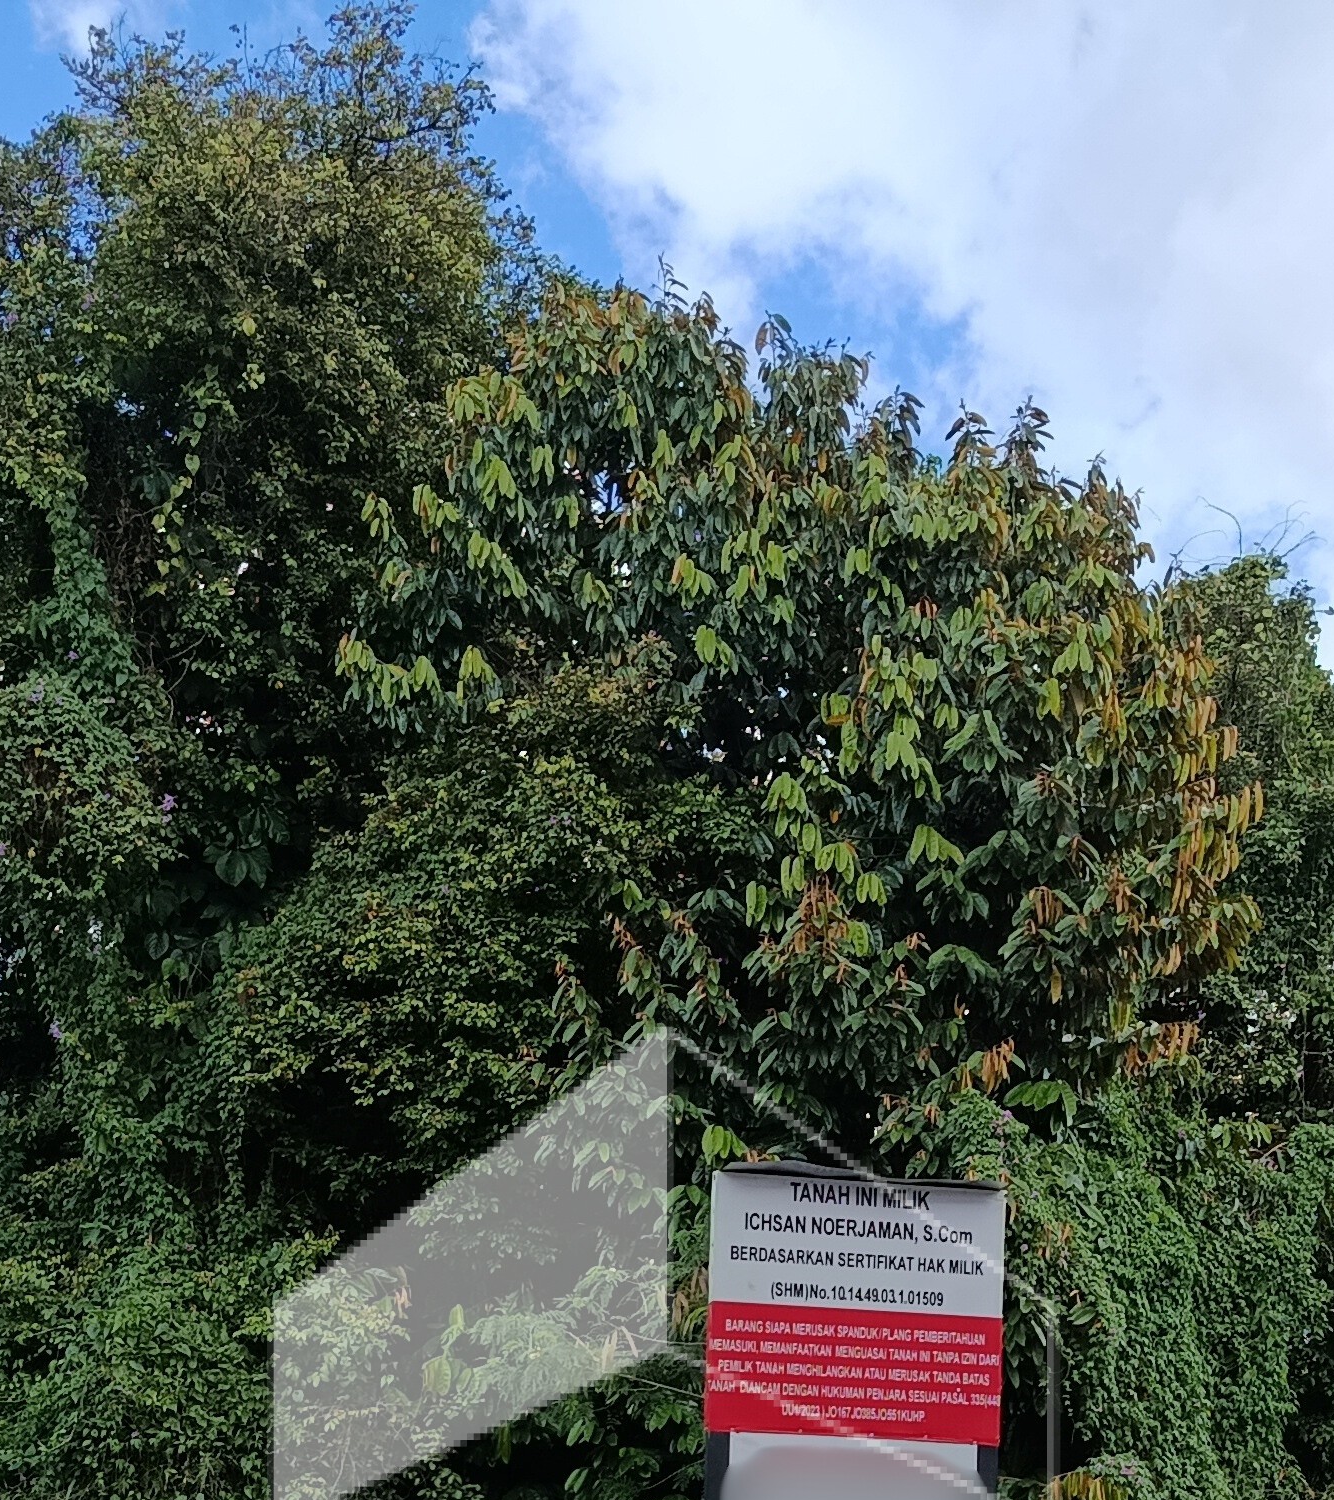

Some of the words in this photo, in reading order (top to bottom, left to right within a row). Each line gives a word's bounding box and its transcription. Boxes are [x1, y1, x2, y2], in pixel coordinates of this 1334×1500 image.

[790, 1182, 850, 1205] TANAH
[855, 1186, 878, 1208] INI
[882, 1188, 930, 1210] MILIK
[745, 1212, 806, 1234] ICHSAN
[812, 1217, 918, 1244] NOERJAMAN,
[923, 1224, 973, 1244] S.Com
[730, 1245, 834, 1267] BERDASARKAN
[837, 1252, 914, 1271] SERTIFIKAT
[917, 1257, 945, 1274] HAK
[949, 1259, 984, 1275] MILIK
[725, 1318, 764, 1333] BARANG
[765, 1320, 791, 1334] SIAPA
[792, 1322, 836, 1337] MERUSAK
[837, 1325, 911, 1341] SPANDUK/PLANG
[913, 1329, 986, 1345] PEMBERITAHUAN
[760, 1340, 832, 1357] MEMANFAATKAN
[835, 1345, 887, 1360] MENGUASAI
[889, 1348, 917, 1362] TANAH
[919, 1350, 930, 1363] INI
[932, 1351, 960, 1364] TANPA
[979, 1353, 1000, 1366] DARI
[717, 1359, 754, 1373] PEMILIK
[755, 1361, 785, 1374] TANAH
[786, 1363, 863, 1378] MENGHILANGKAN
[864, 1367, 886, 1380] ATAU
[888, 1368, 931, 1382] MERUSAK
[932, 1370, 961, 1384] TANDA
[962, 1372, 990, 1386] BATAS
[739, 1380, 781, 1395] DIANCAM
[782, 1383, 819, 1396] DENGAN
[820, 1385, 865, 1399] HUKUMAN
[867, 1387, 907, 1402] PENJARA
[908, 1389, 940, 1403] SESUAI
[941, 1391, 970, 1405] PASAL
